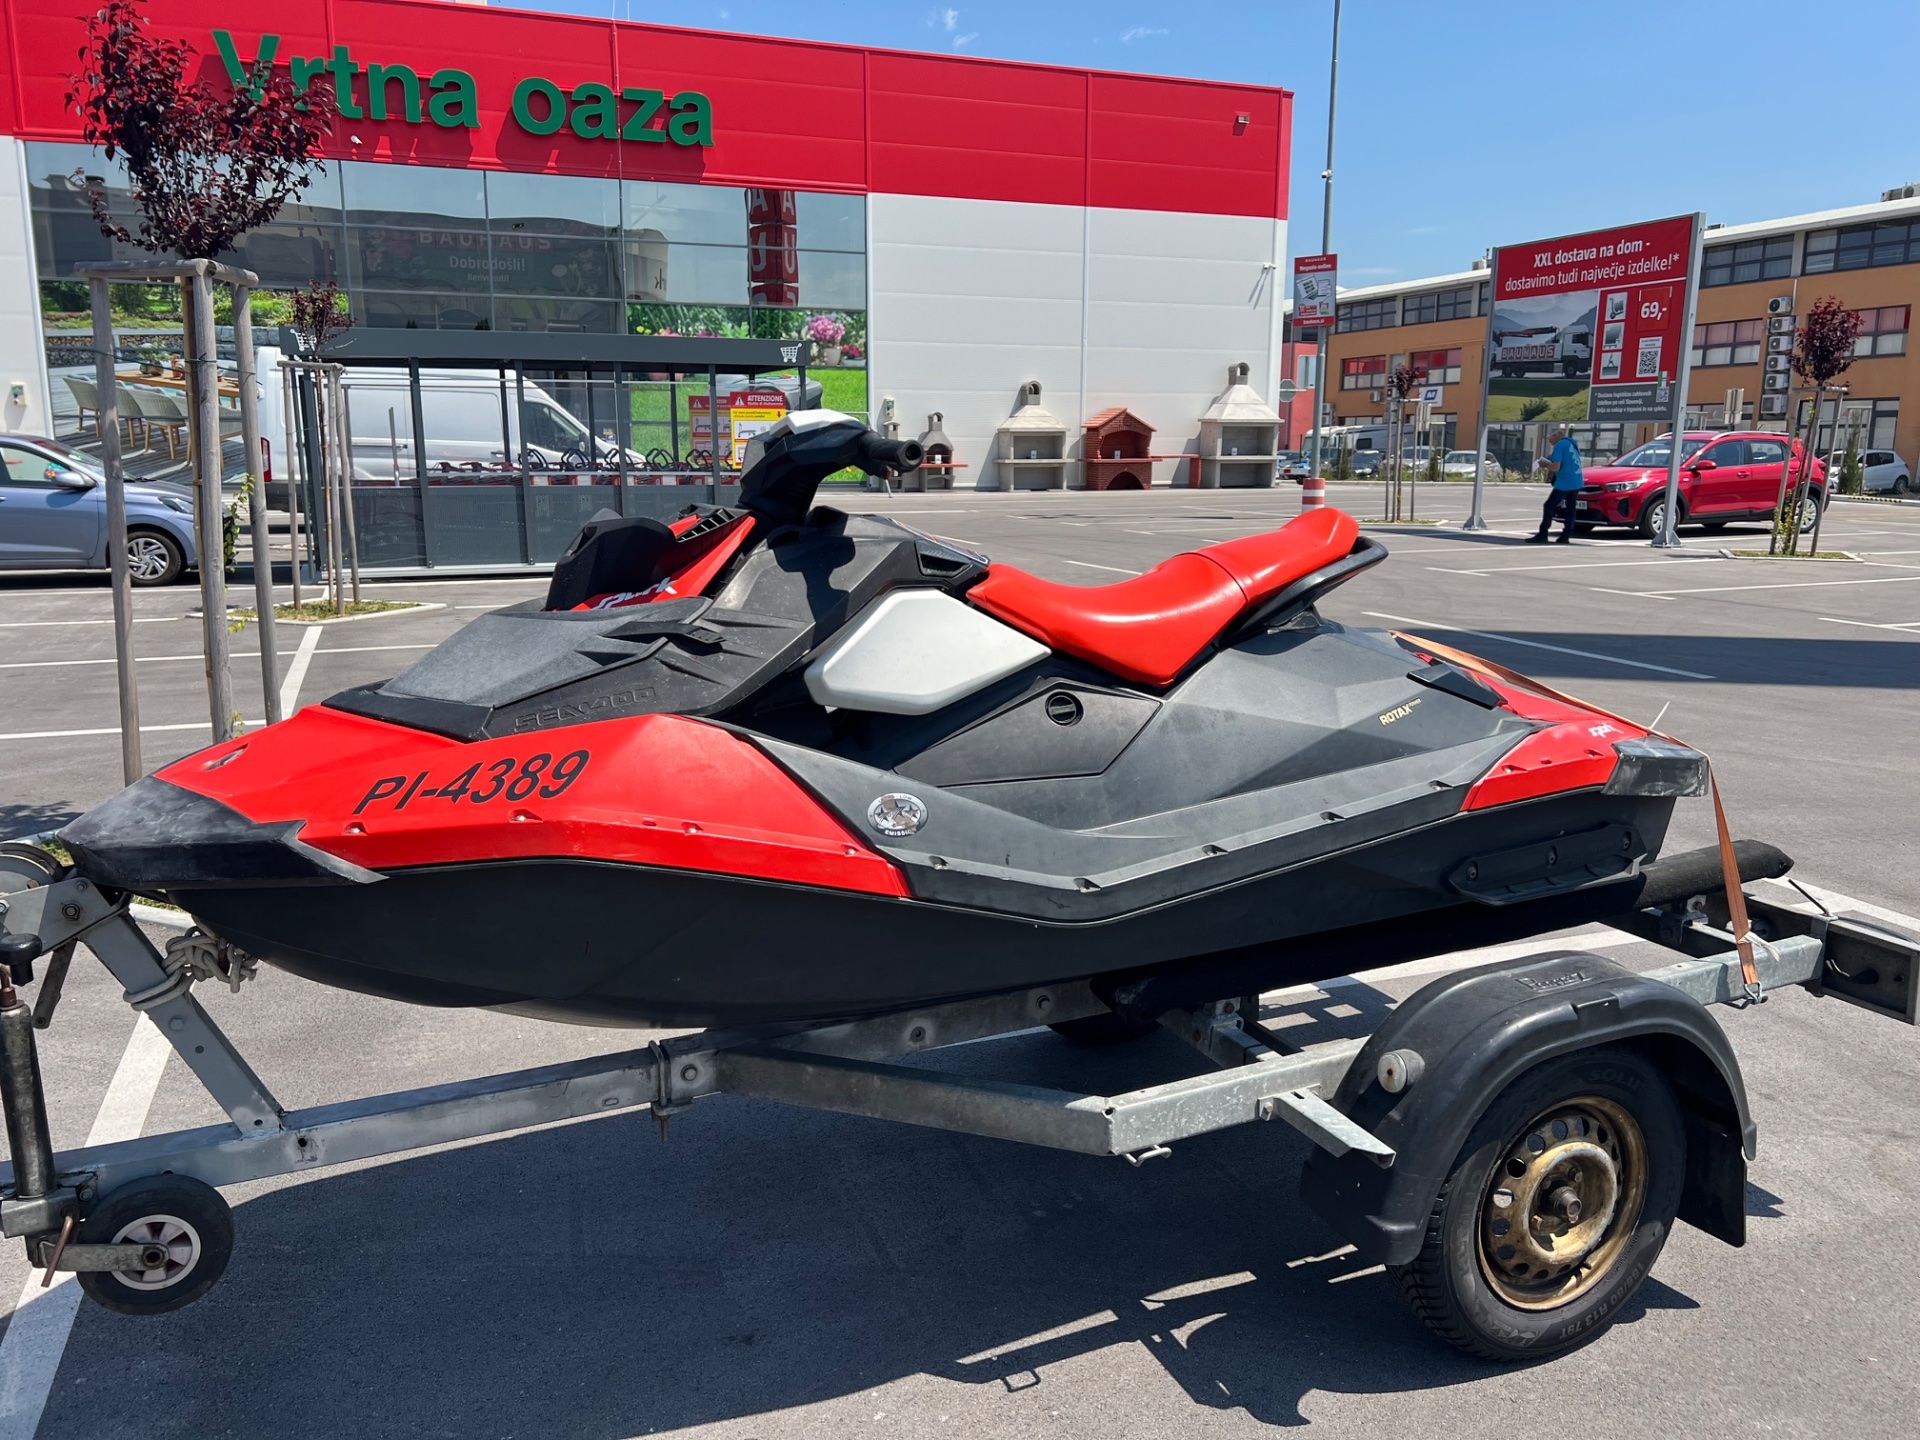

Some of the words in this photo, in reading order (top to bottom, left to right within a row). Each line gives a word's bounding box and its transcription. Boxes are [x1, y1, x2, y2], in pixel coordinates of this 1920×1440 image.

[212, 29, 479, 127] Vrtna
[512, 77, 714, 147] oaza
[1533, 252, 1552, 268] XXL
[1554, 247, 1597, 264] dostava
[1599, 244, 1614, 258] na
[1616, 239, 1643, 255] dom
[1505, 273, 1556, 292] dostavimo
[1558, 268, 1579, 284] tudi
[1580, 263, 1625, 282] največje
[1640, 301, 1668, 320] 69,-
[1502, 345, 1555, 358] BAUHAUS
[1379, 704, 1412, 725] ROTAX
[352, 749, 590, 815] PI-4389
